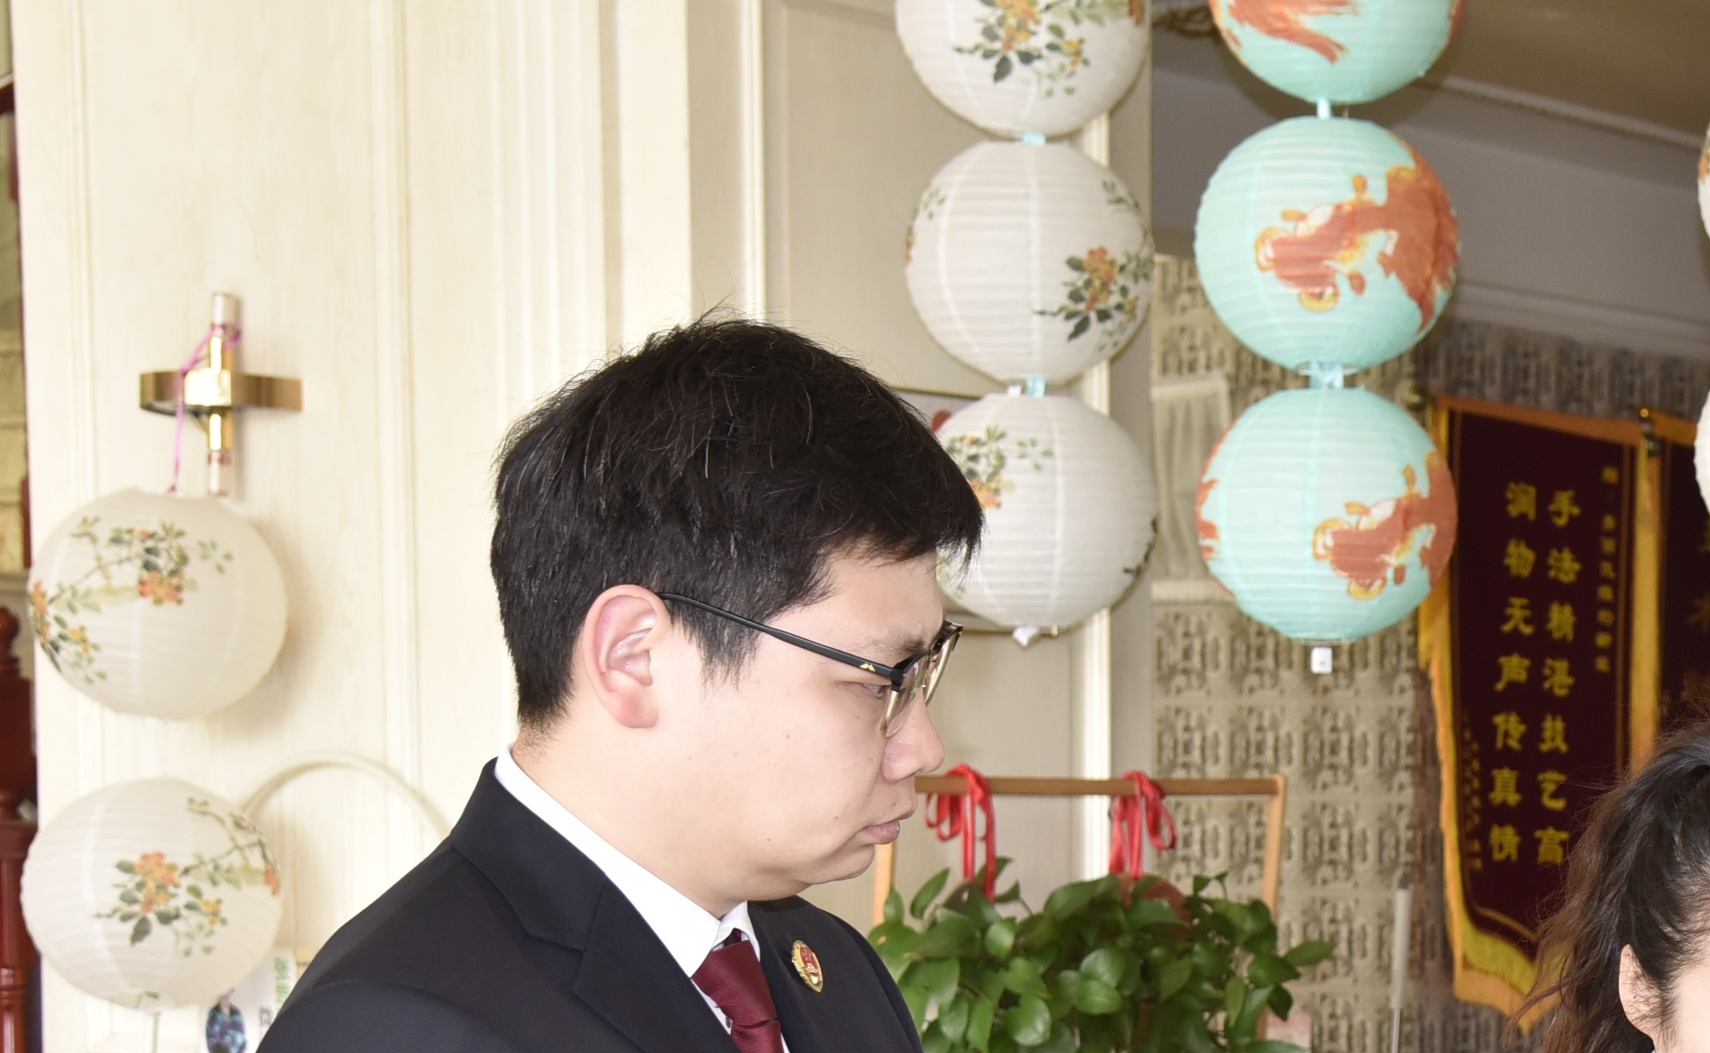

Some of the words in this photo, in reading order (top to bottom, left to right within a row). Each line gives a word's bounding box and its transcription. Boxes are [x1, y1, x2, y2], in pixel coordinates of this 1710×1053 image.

[1488, 481, 1537, 862] 润物无声传真情
[1534, 490, 1581, 864] 手法精湛技艺高
